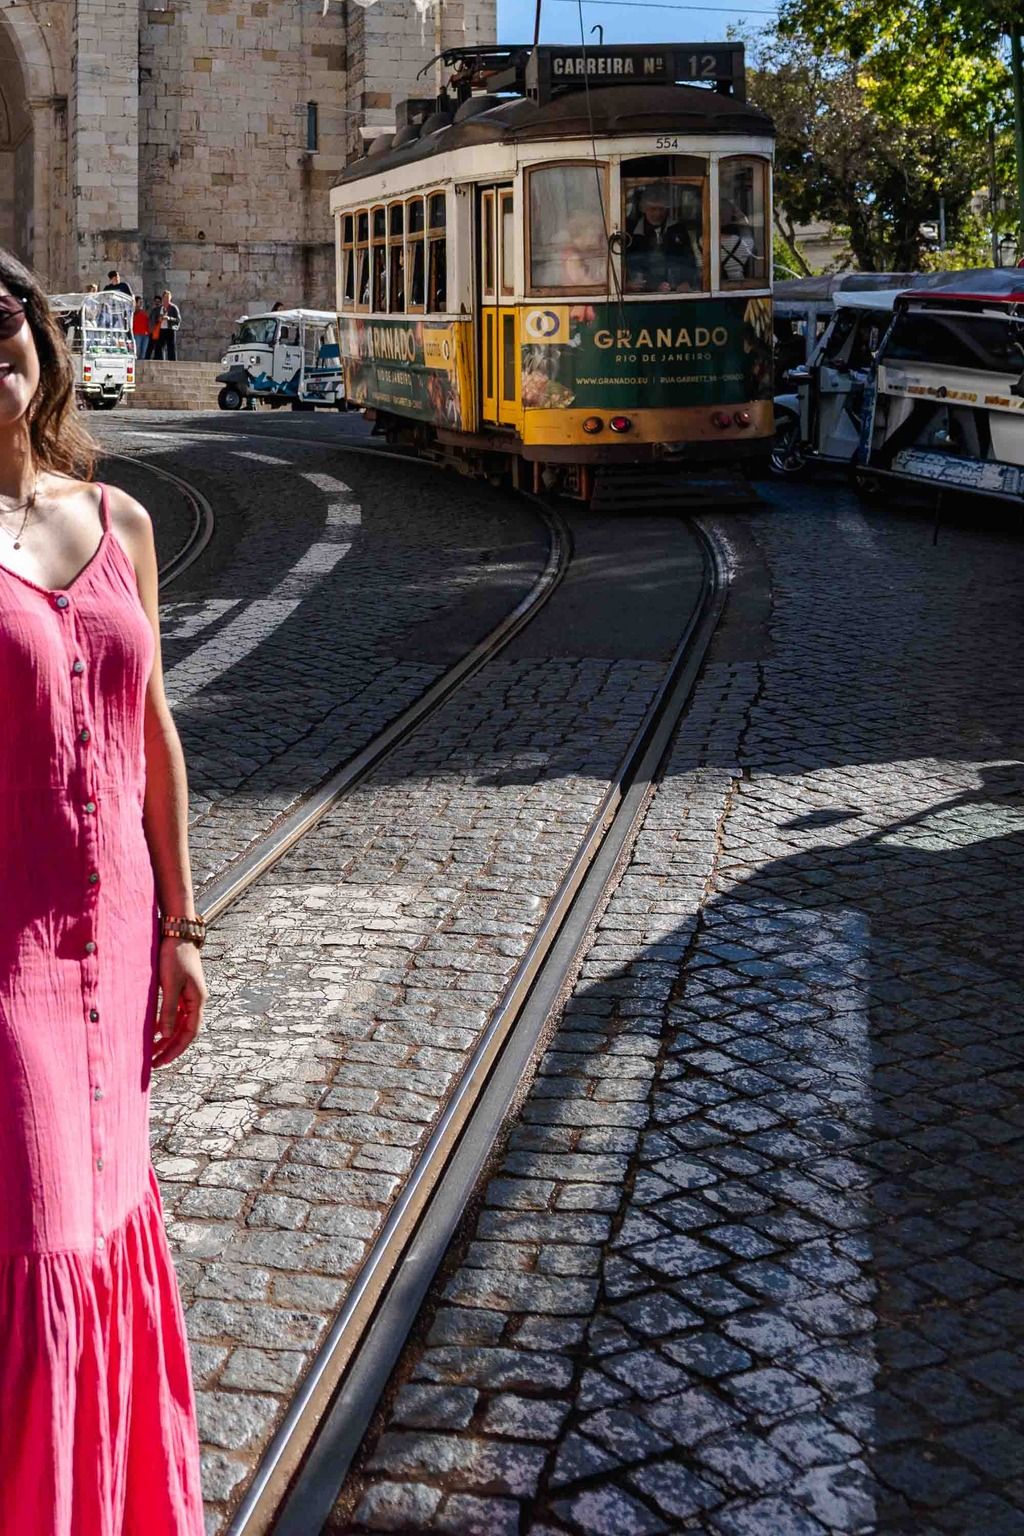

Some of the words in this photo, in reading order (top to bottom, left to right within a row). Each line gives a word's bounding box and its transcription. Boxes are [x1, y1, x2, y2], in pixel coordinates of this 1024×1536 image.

[553, 57, 634, 75] CARREIRA
[688, 55, 716, 77] 12
[656, 137, 678, 149] 554
[593, 326, 728, 349] GRANADO
[616, 354, 637, 363] RIO
[642, 354, 656, 362] DE
[661, 353, 712, 362] JANEIRO
[576, 377, 648, 385] WWW.GRANADO.EU
